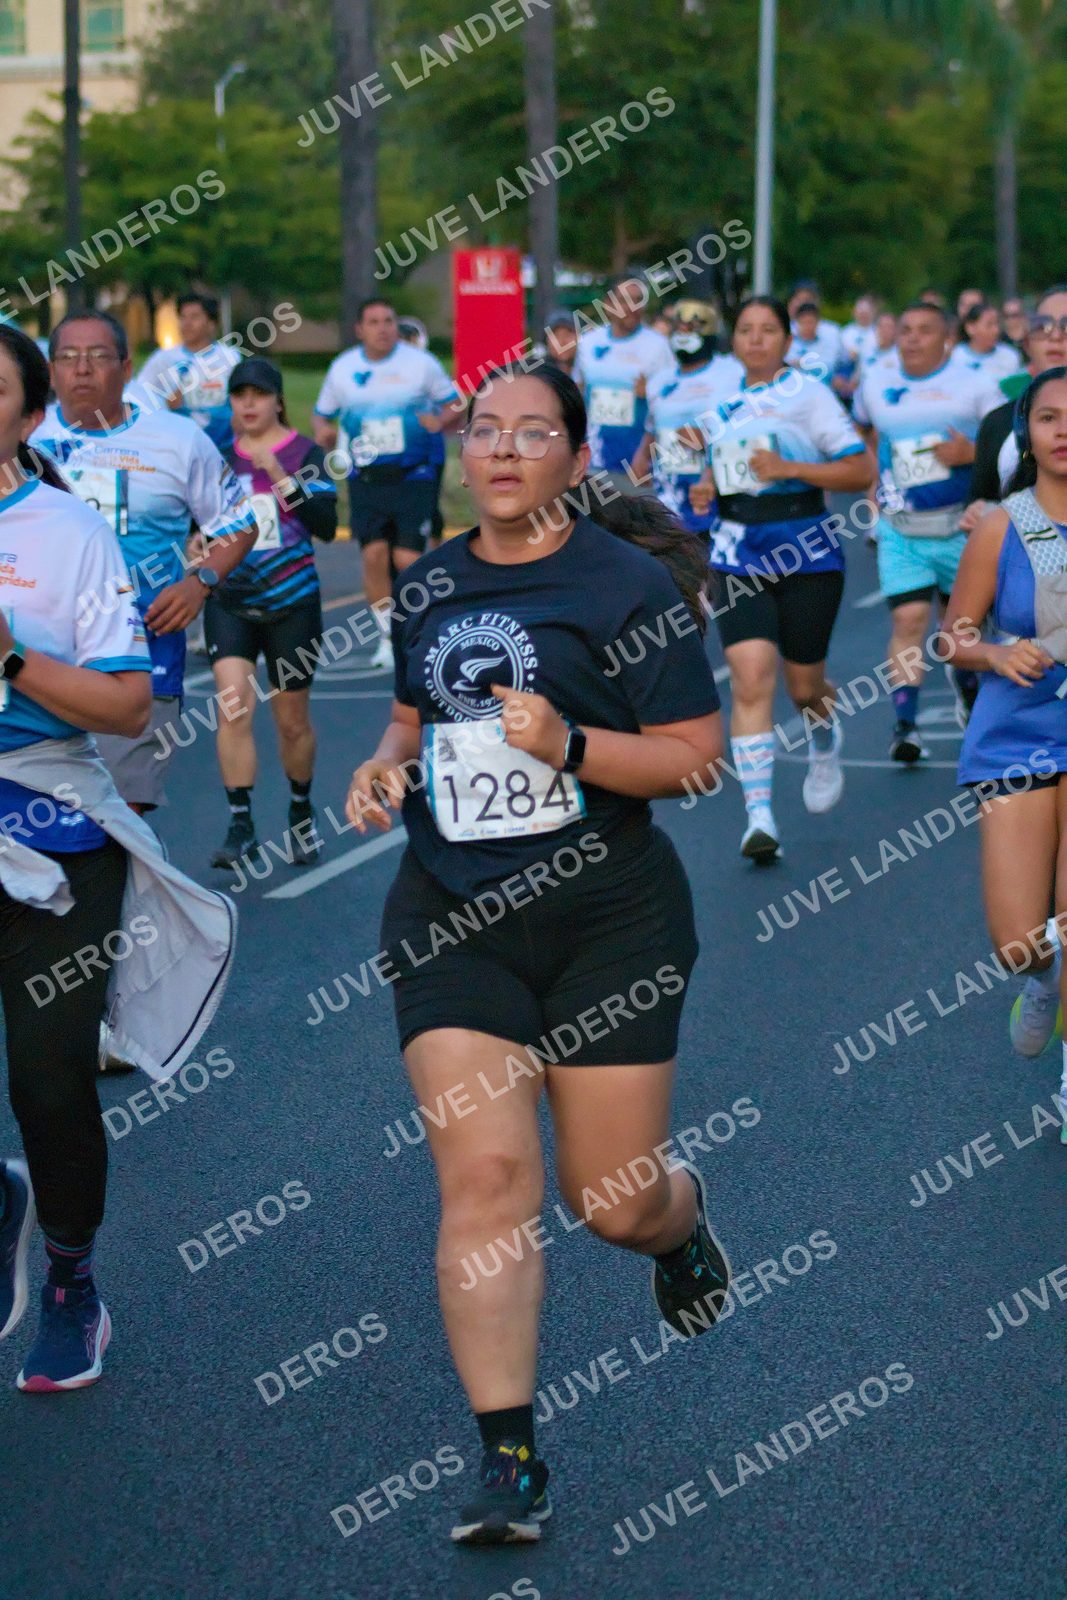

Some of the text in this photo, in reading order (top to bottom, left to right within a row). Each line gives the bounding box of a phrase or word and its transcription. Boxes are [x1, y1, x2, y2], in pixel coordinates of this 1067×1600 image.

[424, 613, 538, 670] MARC FITNESS
[460, 636, 500, 651] MEXICO
[443, 769, 574, 824] 1284
